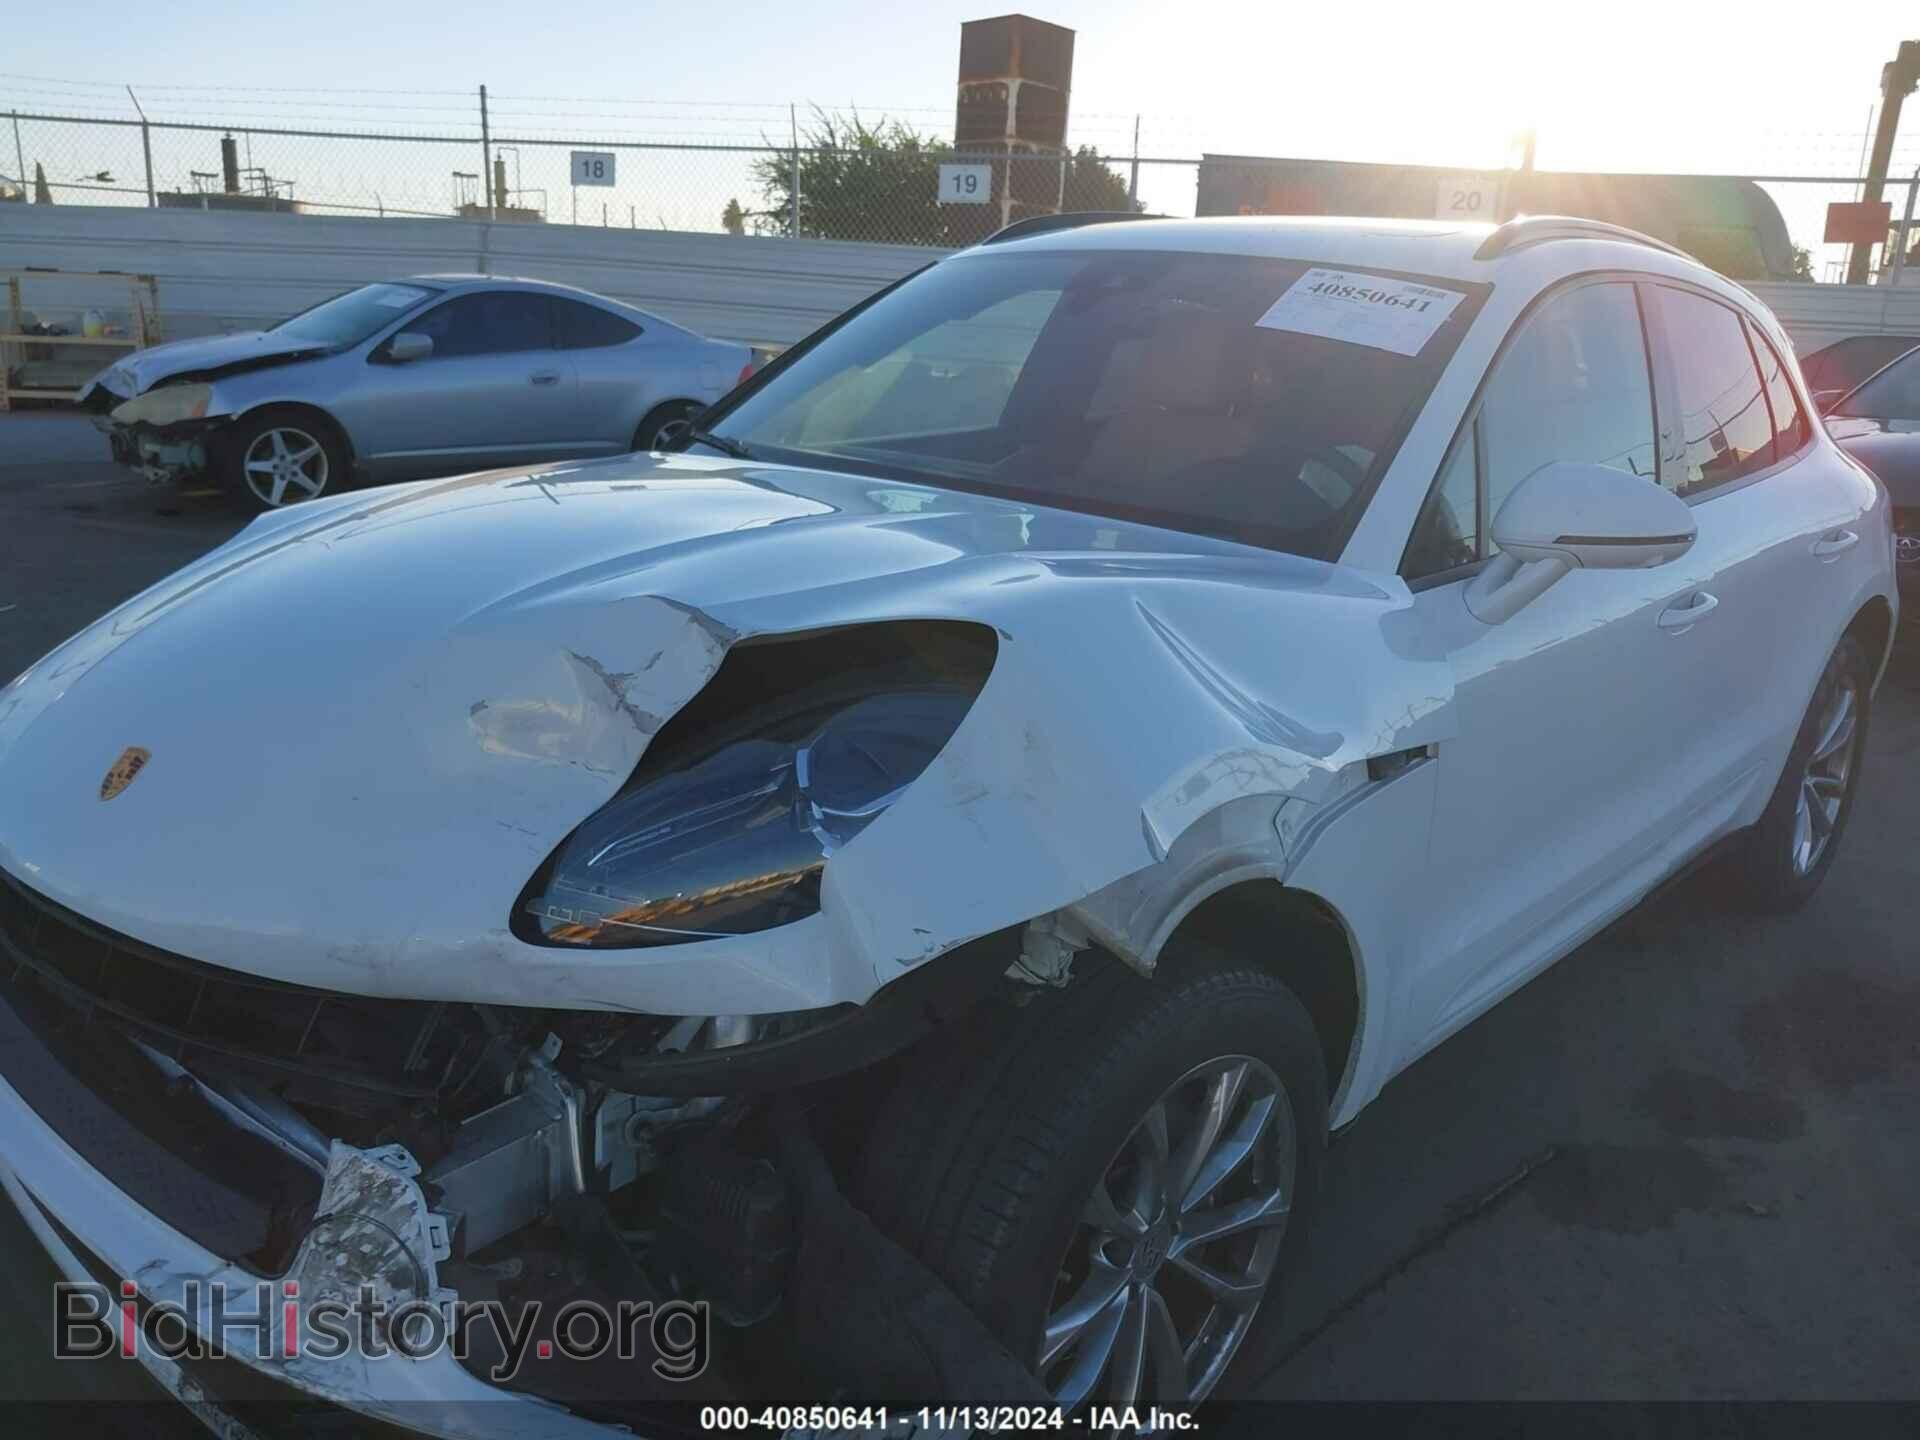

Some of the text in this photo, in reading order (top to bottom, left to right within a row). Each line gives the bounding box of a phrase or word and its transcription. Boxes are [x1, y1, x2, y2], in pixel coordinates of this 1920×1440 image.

[582, 160, 605, 178] 18
[952, 174, 977, 194] 19
[1451, 191, 1482, 210] 20
[1308, 282, 1432, 312] 40850641
